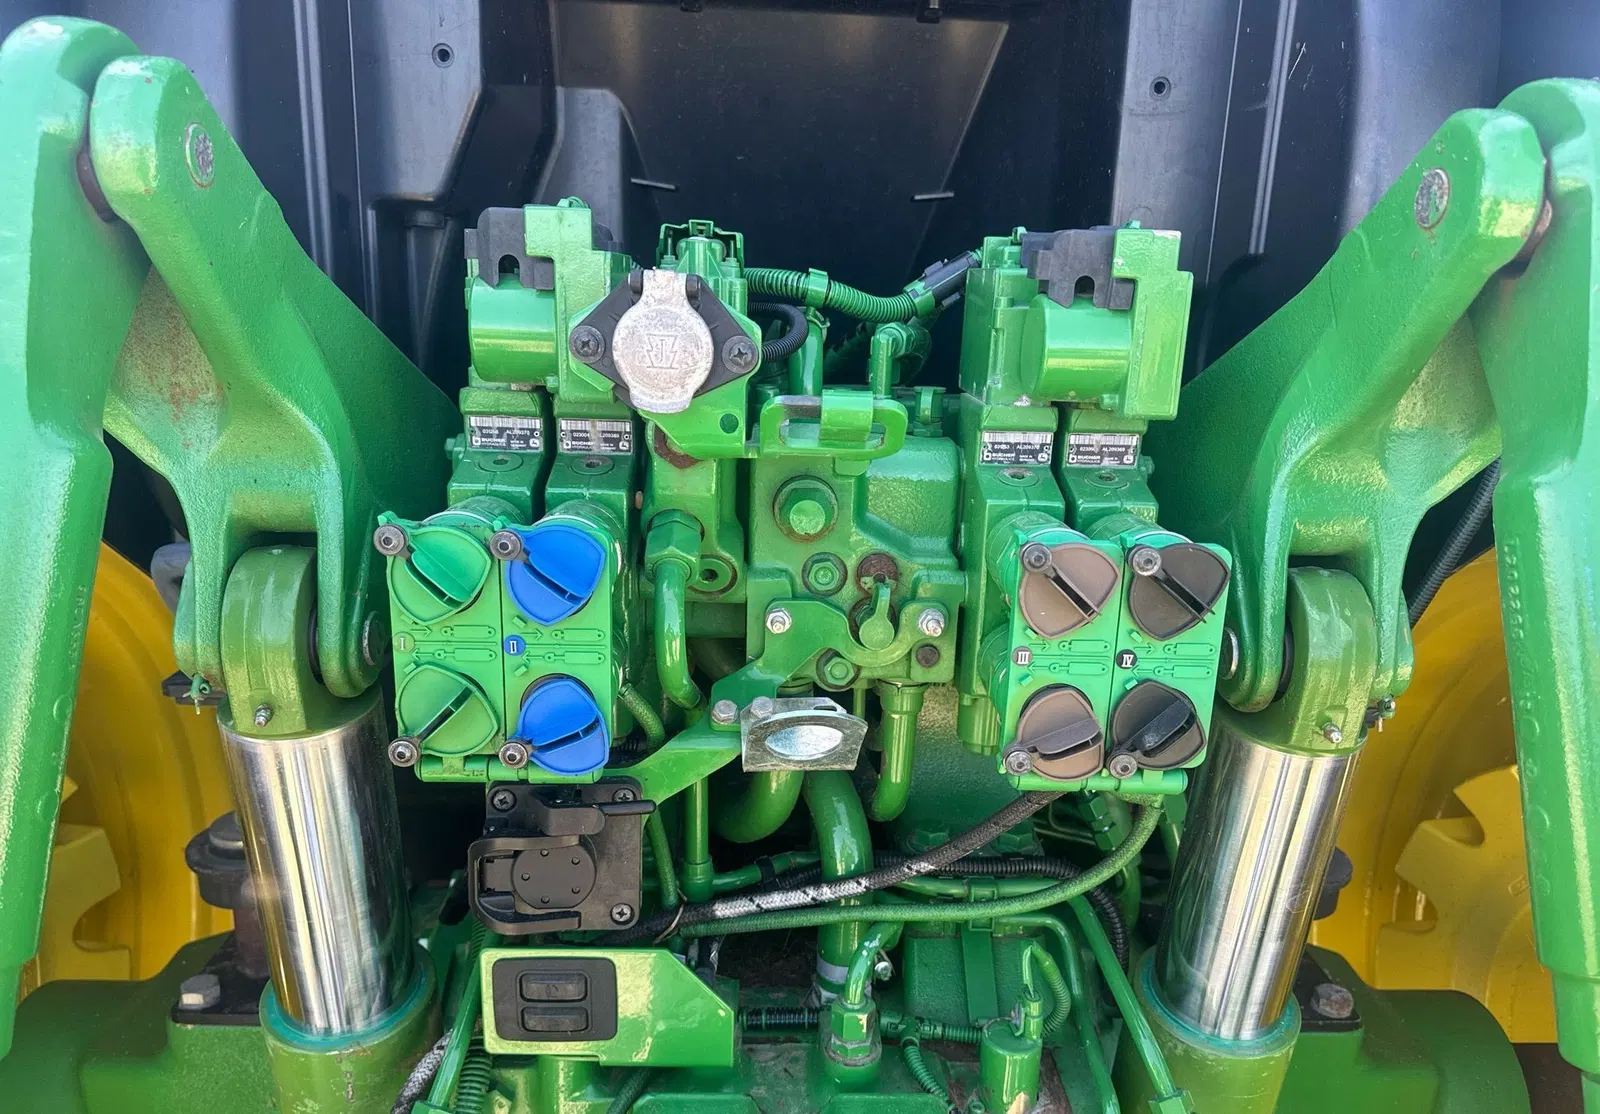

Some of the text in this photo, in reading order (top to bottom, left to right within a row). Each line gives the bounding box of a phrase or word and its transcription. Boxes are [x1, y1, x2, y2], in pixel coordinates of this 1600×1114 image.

[399, 637, 405, 651] I
[509, 640, 517, 654] II
[1017, 651, 1030, 664] III
[1121, 654, 1135, 667] IV
